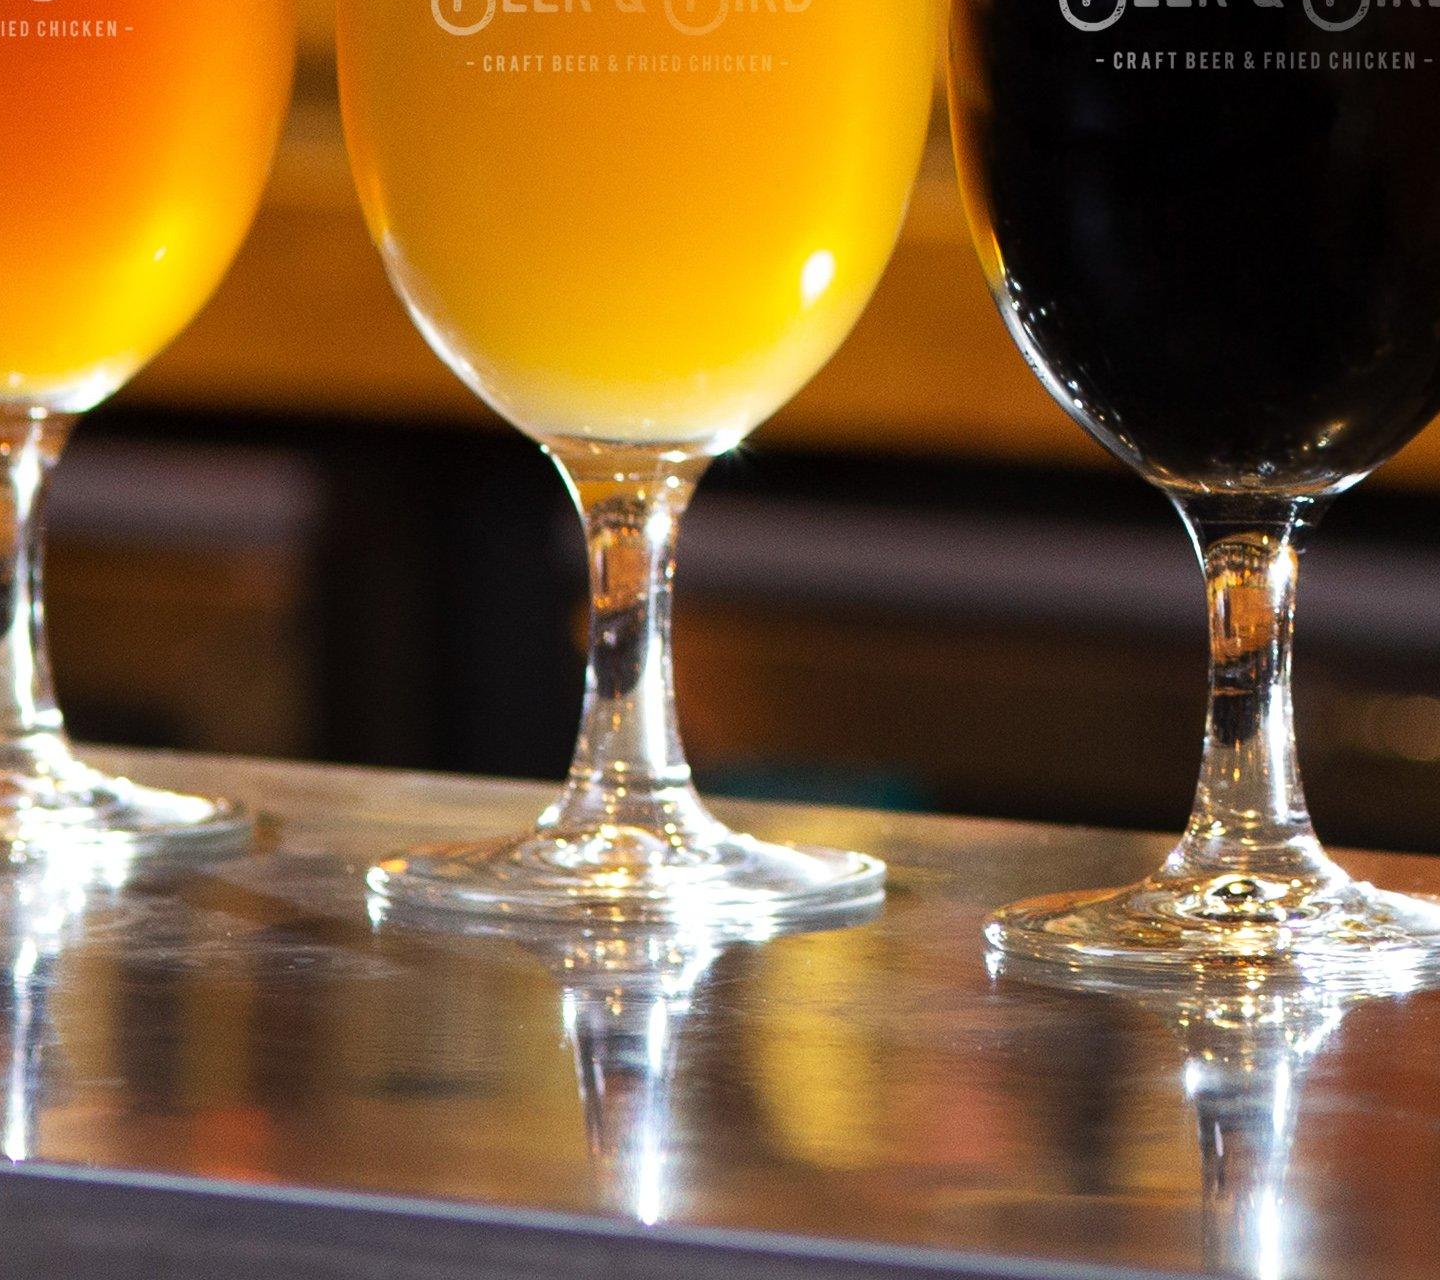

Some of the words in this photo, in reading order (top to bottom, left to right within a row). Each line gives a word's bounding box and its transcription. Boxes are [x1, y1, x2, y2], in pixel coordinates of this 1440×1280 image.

[37, 20, 118, 38] CHICKEN
[483, 54, 545, 73] CRAFT
[552, 54, 599, 73] BEER
[608, 54, 619, 73] &
[626, 54, 682, 73] FRIED
[689, 54, 773, 73] CHICKEN
[1113, 51, 1177, 70] CRAFT
[1185, 51, 1235, 70] BEER
[1243, 51, 1255, 70] &
[1263, 51, 1321, 70] FRIED
[1328, 51, 1416, 70] CHICKEN
